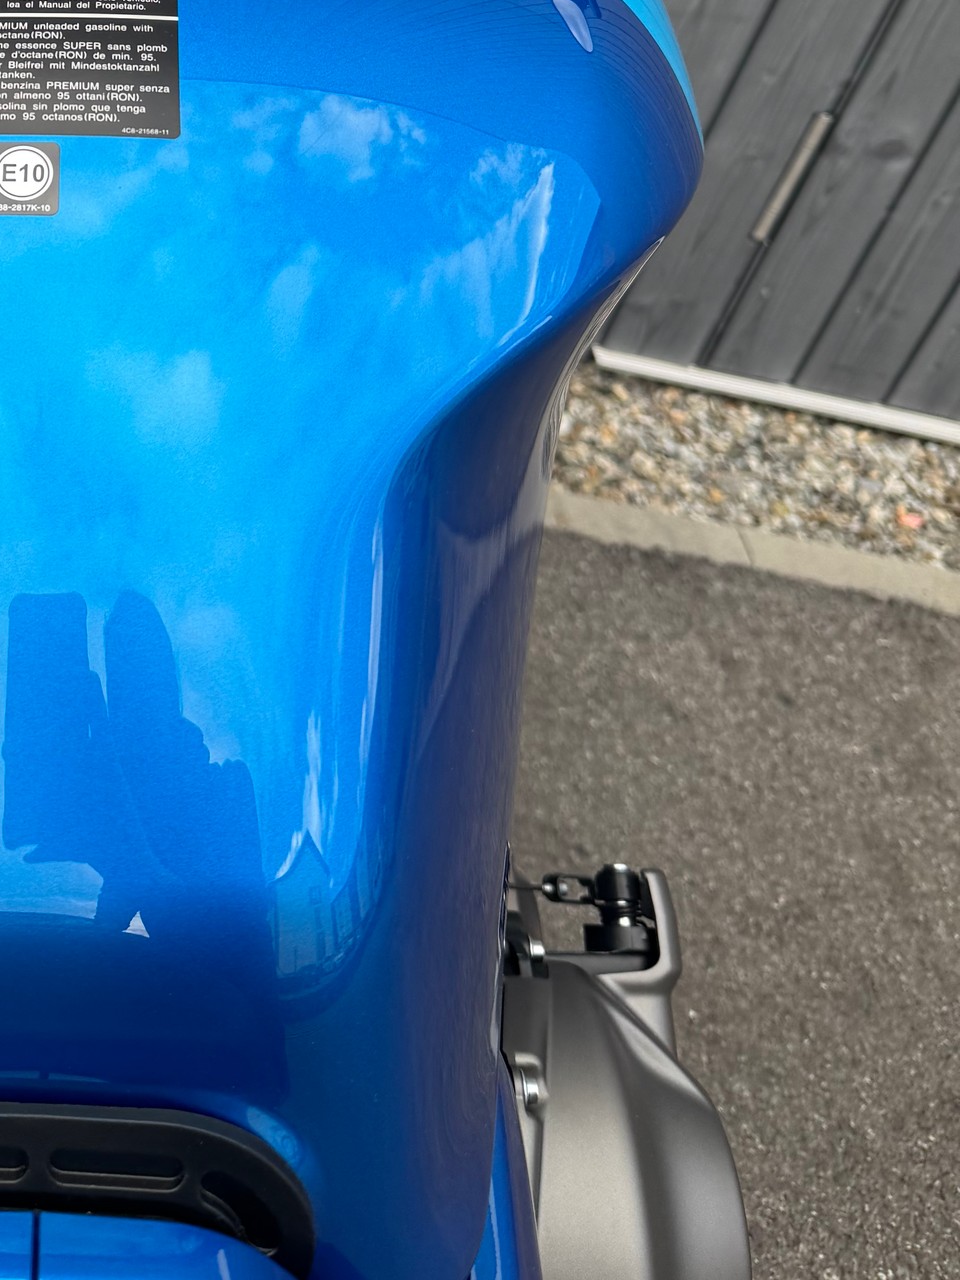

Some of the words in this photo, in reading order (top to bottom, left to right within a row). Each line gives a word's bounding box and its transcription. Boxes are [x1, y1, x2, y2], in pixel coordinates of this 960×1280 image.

[7, 1, 21, 9] lea
[95, 2, 146, 11] Propietario.
[33, 23, 80, 31] unleaded
[85, 23, 127, 33] gasoline
[133, 24, 154, 32] with
[63, 42, 102, 51] SUPER
[136, 44, 168, 53] plomb
[11, 50, 87, 60] d'octane(RON)
[93, 51, 106, 60] de
[111, 52, 133, 60] min.
[140, 53, 156, 61] 95.
[8, 61, 43, 70] Bleifrei
[49, 61, 66, 70] mit
[71, 61, 160, 72] Mindestoktanzahl
[0, 81, 41, 89] benzina
[46, 81, 100, 91] PREMIUM
[105, 84, 134, 93] super
[139, 85, 170, 93] senza
[13, 91, 52, 100] almeno
[57, 92, 70, 100] 95
[76, 92, 143, 102] ottani(RON).
[32, 103, 47, 111] sin
[53, 103, 85, 113] plomo
[90, 105, 111, 114] que
[116, 105, 146, 114] tenga
[22, 112, 35, 121] 95
[42, 113, 120, 123] octanos(RON).
[2, 163, 45, 183] E10
